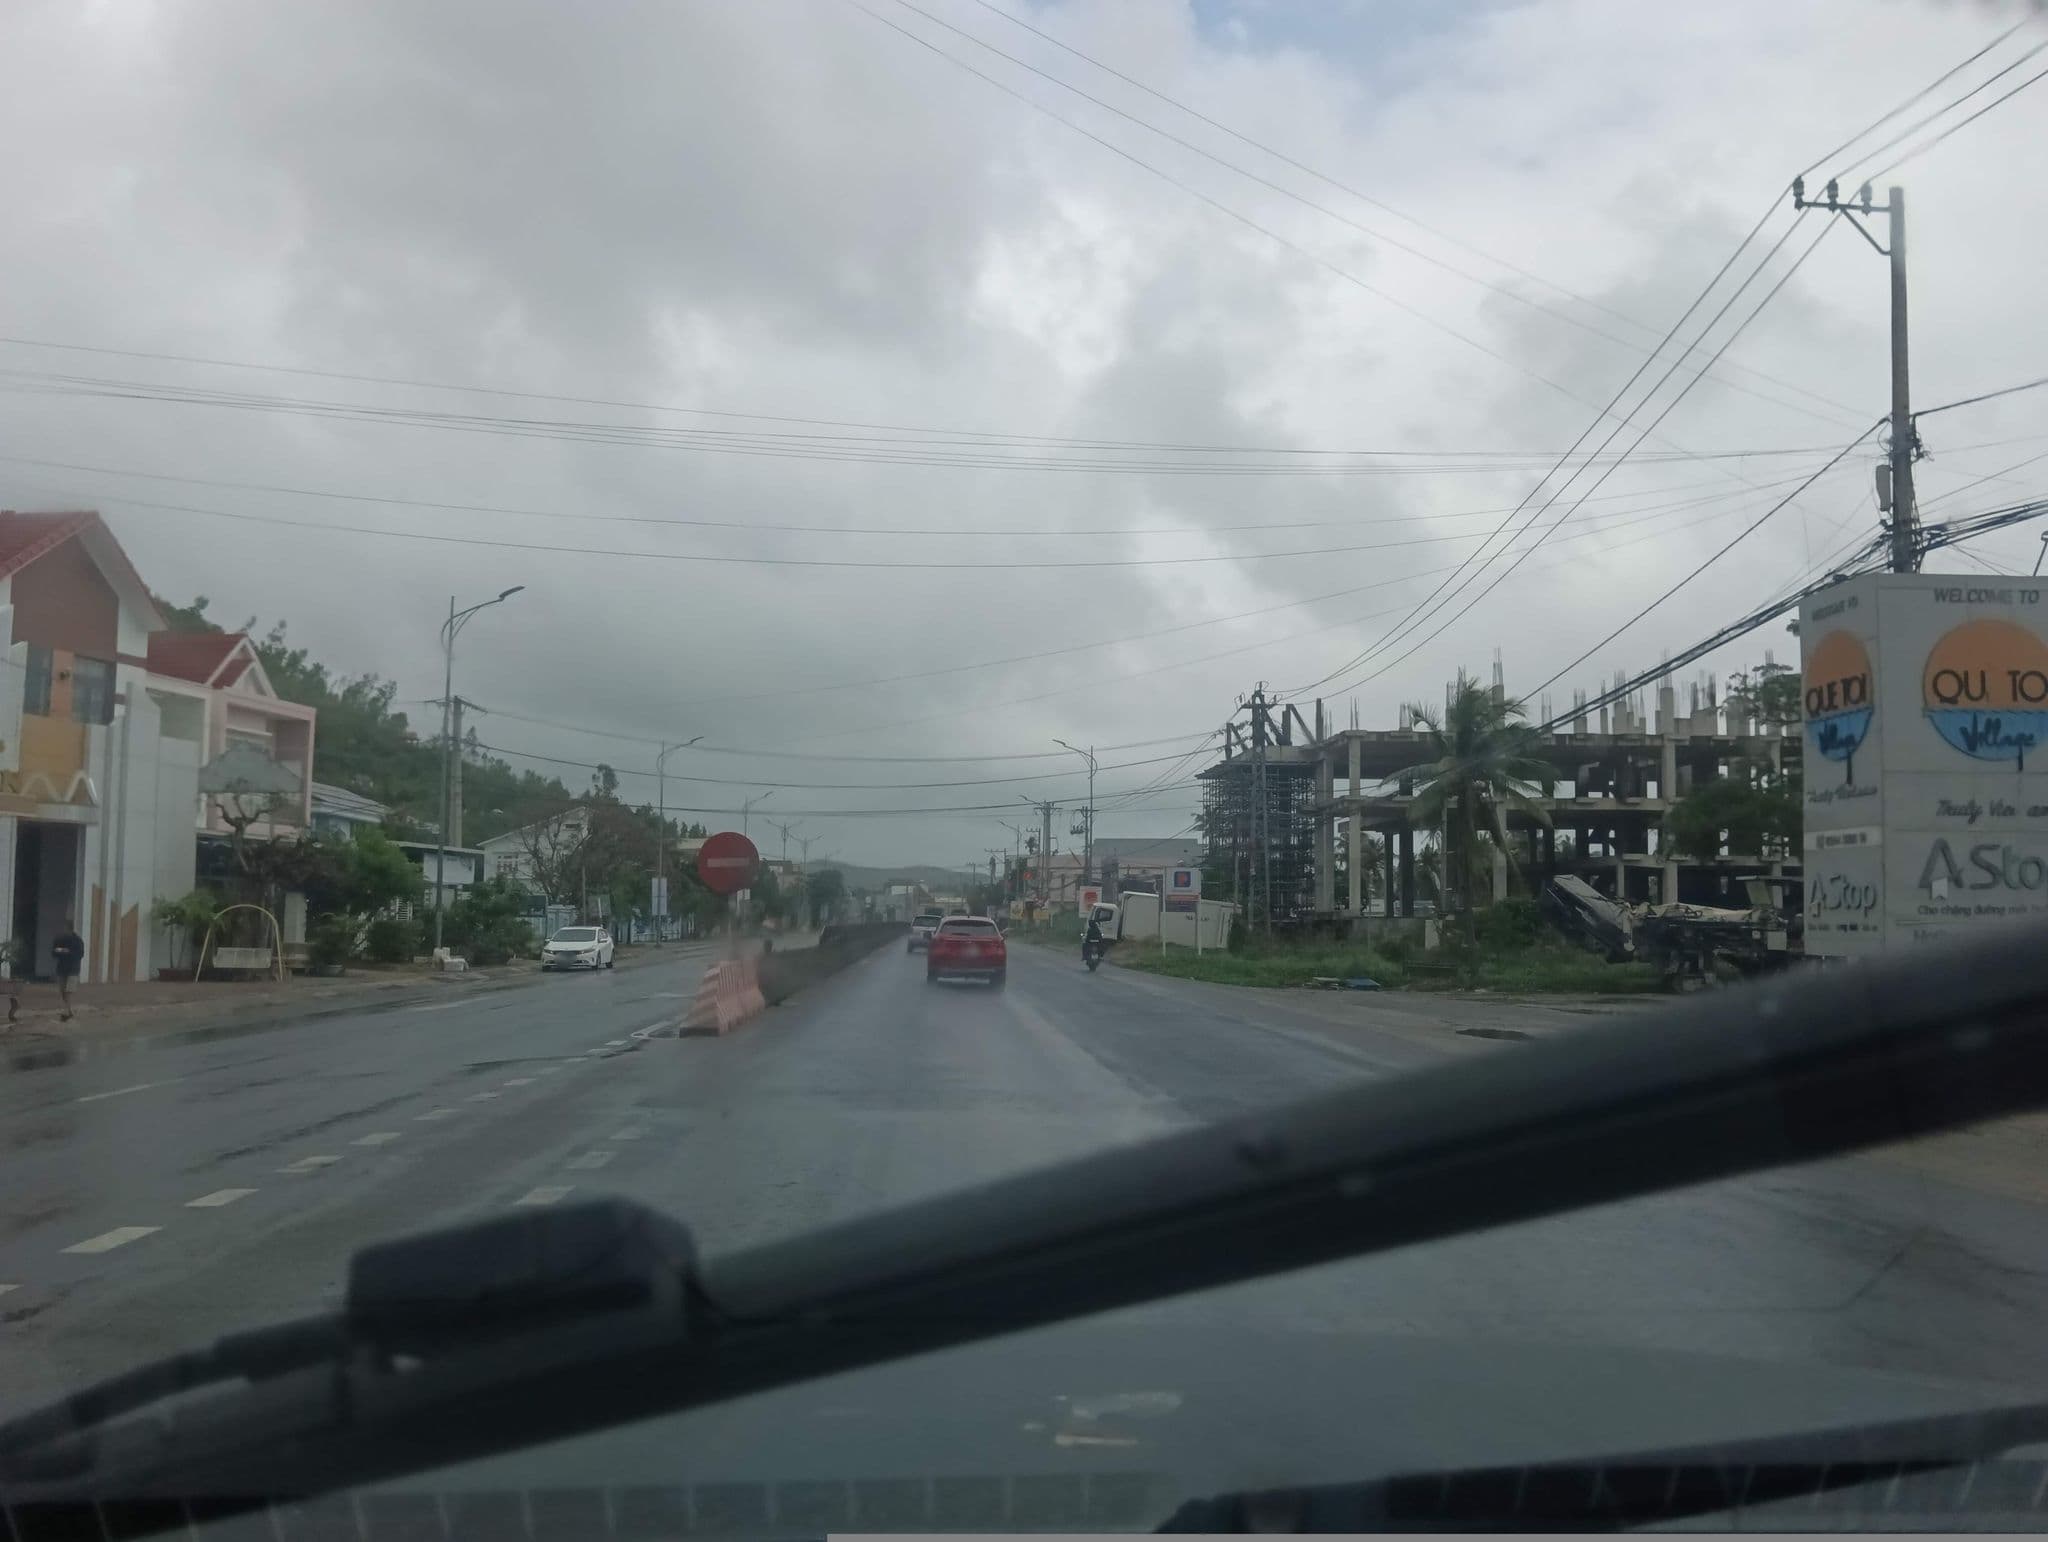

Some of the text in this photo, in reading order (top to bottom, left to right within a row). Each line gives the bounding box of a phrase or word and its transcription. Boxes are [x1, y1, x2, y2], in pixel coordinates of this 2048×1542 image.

[1933, 587, 2041, 604] WELCOME TO
[1958, 713, 2037, 764] Village
